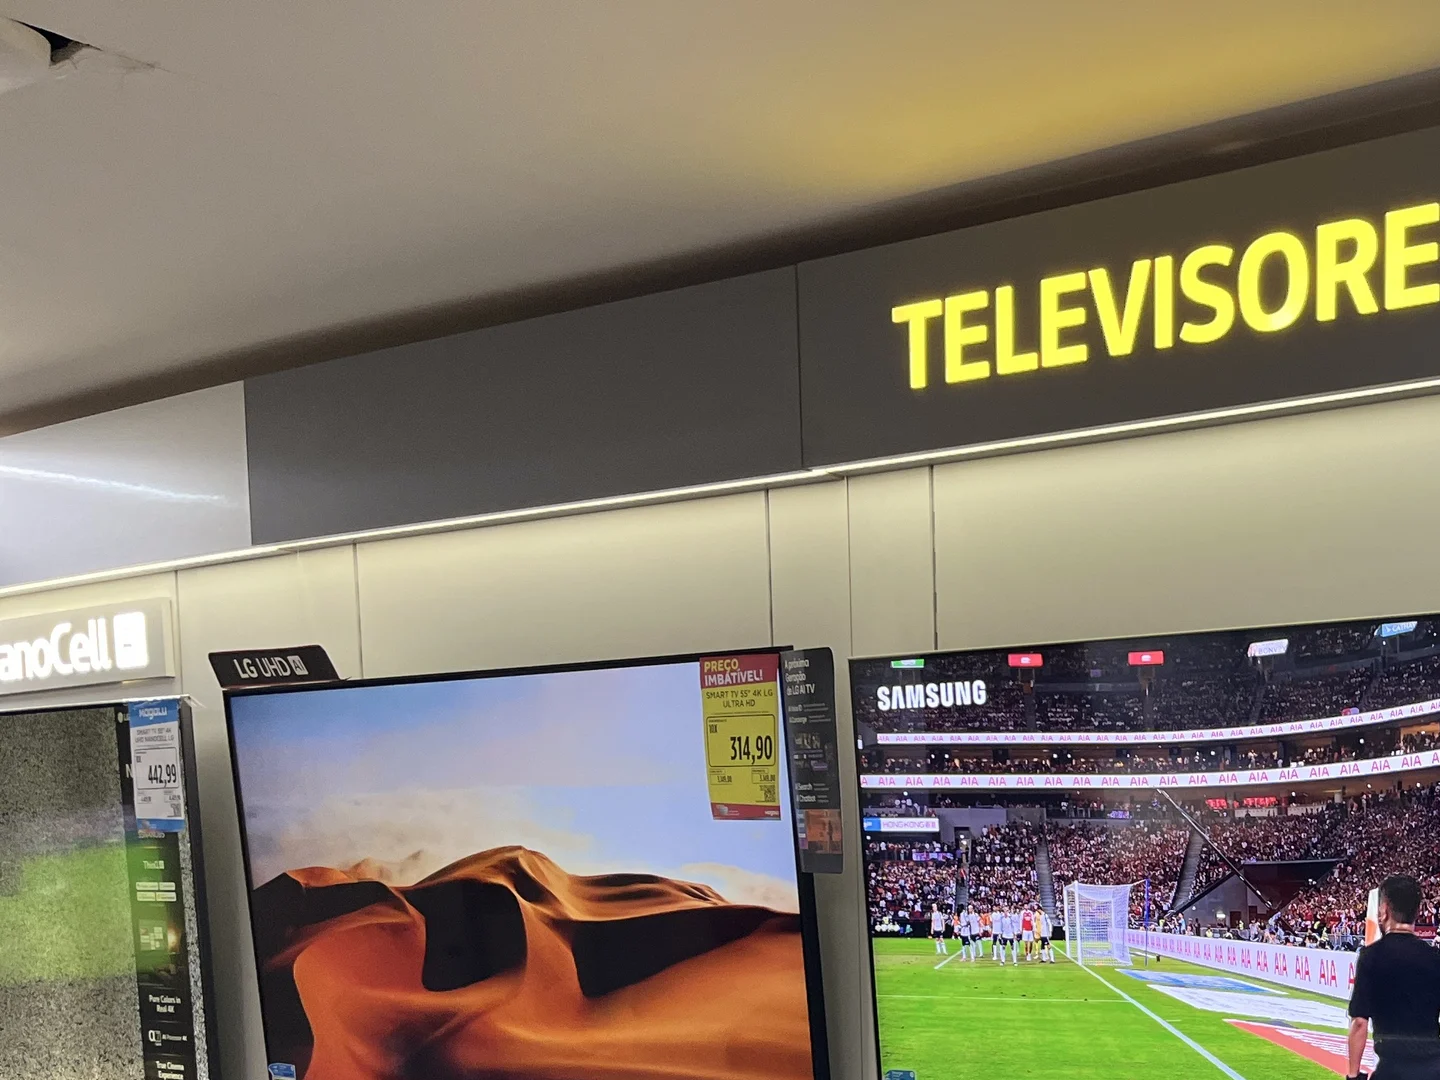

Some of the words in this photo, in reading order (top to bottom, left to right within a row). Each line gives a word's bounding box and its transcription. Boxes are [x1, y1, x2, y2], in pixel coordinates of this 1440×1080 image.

[233, 657, 259, 679] LG
[256, 656, 291, 678] UHD
[704, 658, 739, 674] PREÇO
[705, 669, 764, 687] IMBATÍVEL!
[706, 691, 730, 699] SMART
[763, 689, 773, 697] LG
[723, 700, 744, 708] ULTRA
[877, 680, 987, 711] SAMSUNG
[730, 735, 773, 765] 314,90
[148, 763, 177, 788] 442,99
[906, 775, 924, 787] AIA
[989, 776, 1008, 787] AIA
[1073, 776, 1092, 787] AIA
[1160, 774, 1179, 786] AIA
[1249, 770, 1270, 783] AIA
[1340, 761, 1361, 775] AIA
[1241, 948, 1252, 970] AIA
[1256, 950, 1269, 973] AIA
[1274, 952, 1289, 978] AIA
[1295, 955, 1311, 982] AIA
[1319, 958, 1338, 988] AIA
